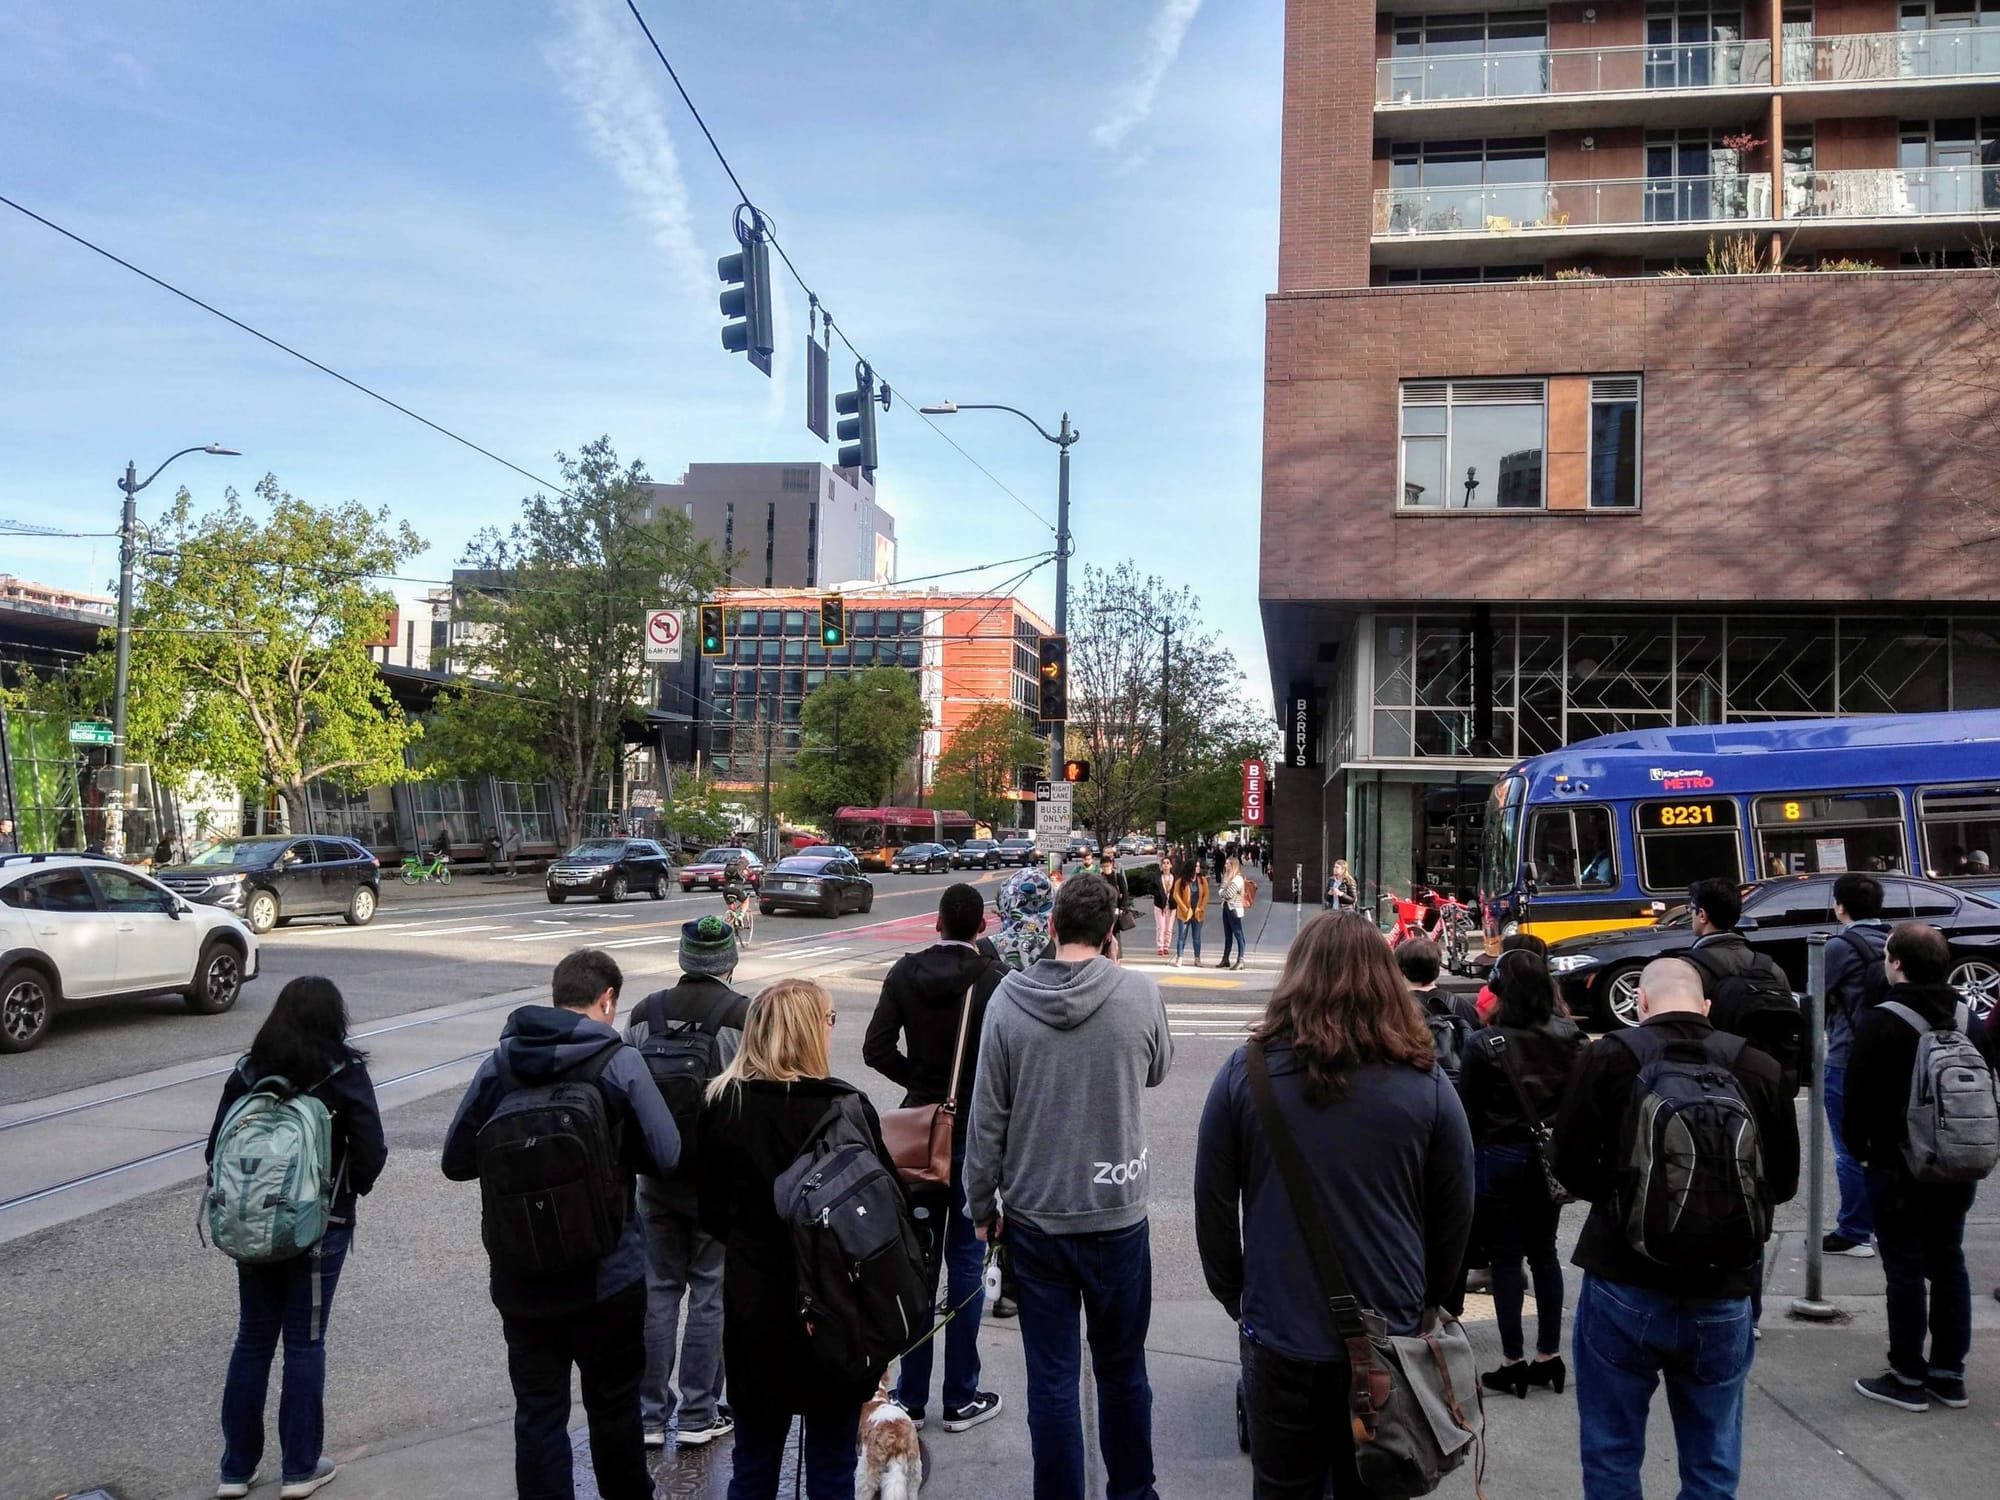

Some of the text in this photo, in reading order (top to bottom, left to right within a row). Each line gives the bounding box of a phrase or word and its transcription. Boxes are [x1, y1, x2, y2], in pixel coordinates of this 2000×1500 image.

[648, 647, 679, 655] 6AM-7PM
[1663, 769, 1704, 778] King County
[1663, 776, 1714, 790] METRO
[1248, 765, 1261, 820] BECU
[1040, 805, 1068, 814] BUSES
[1661, 804, 1713, 825] 8231
[1785, 802, 1800, 819] 8
[1043, 814, 1064, 823] ONLY
